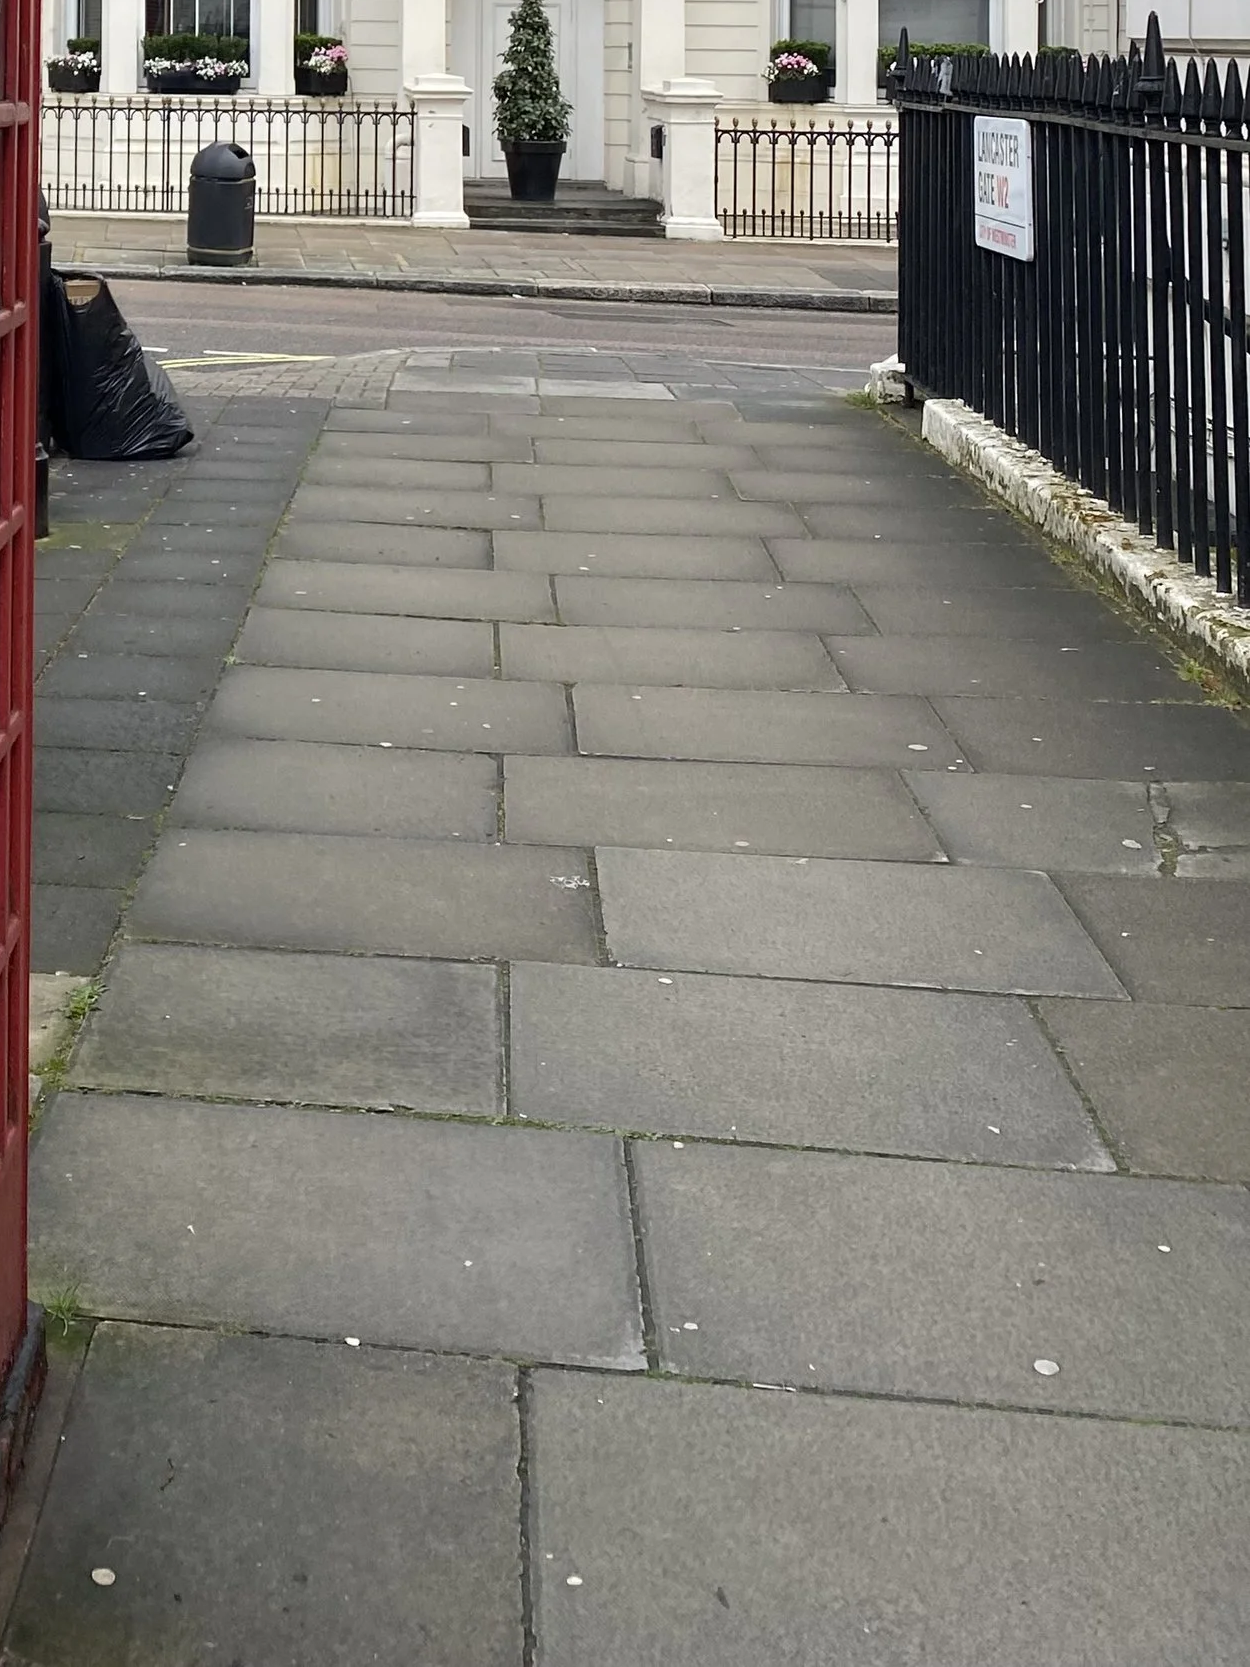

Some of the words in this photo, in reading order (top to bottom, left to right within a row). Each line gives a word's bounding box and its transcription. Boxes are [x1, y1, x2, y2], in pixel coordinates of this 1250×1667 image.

[977, 131, 1019, 168] LANCASTER
[978, 171, 995, 205] GATE
[996, 175, 1009, 209] W2
